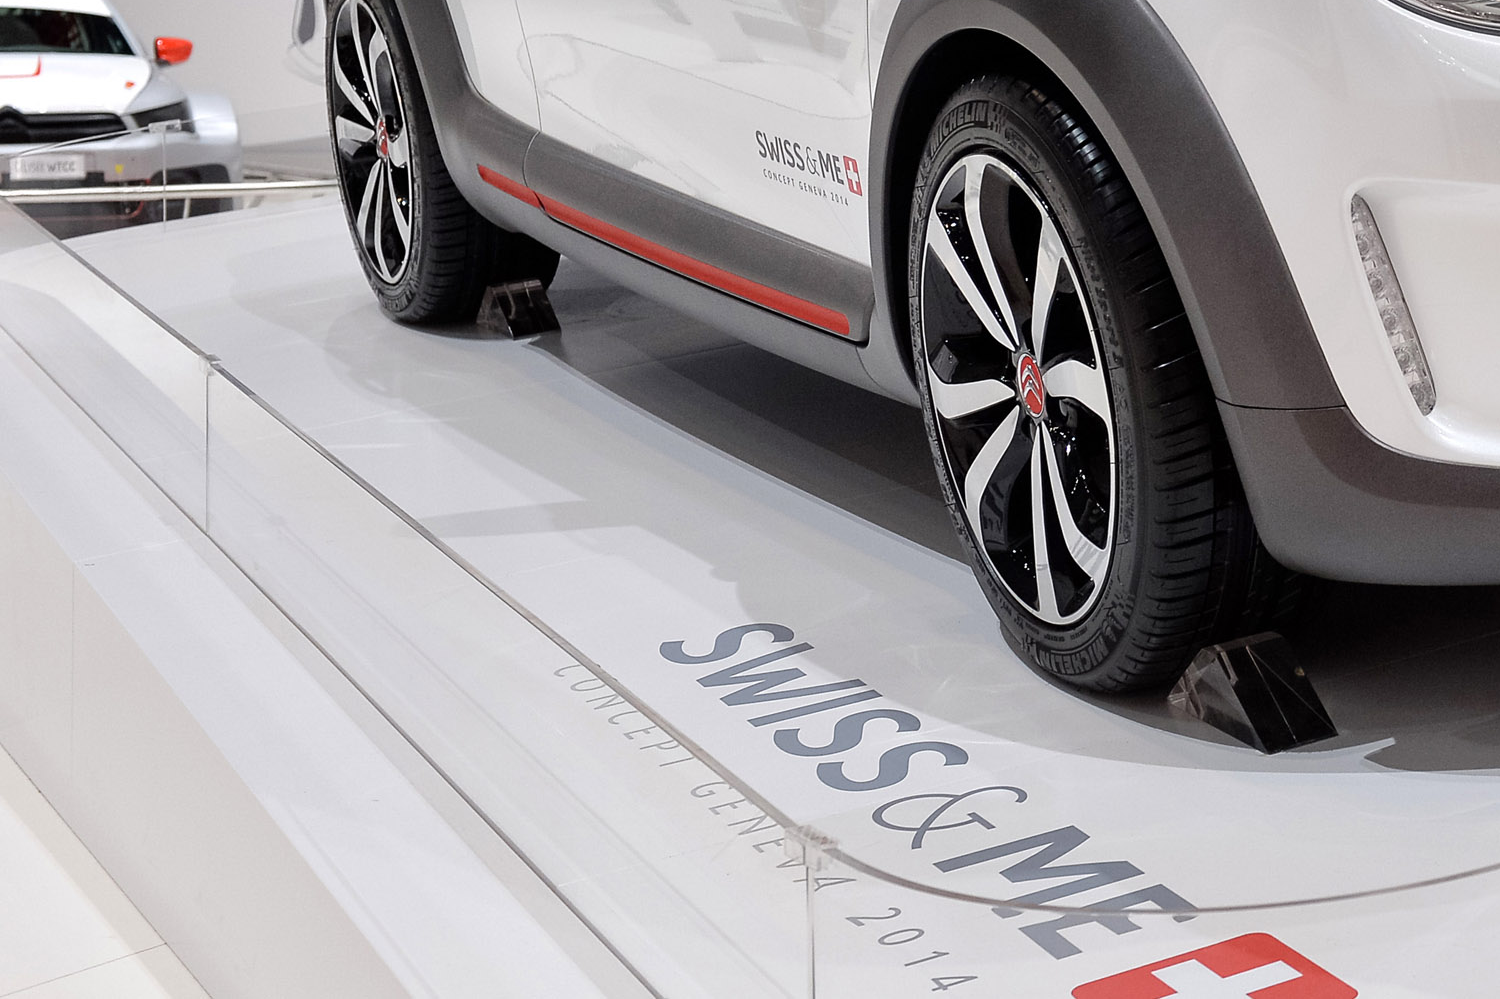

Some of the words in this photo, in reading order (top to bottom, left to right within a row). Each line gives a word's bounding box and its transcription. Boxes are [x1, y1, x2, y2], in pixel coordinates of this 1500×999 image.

[763, 168, 795, 187] CONCEPT
[799, 181, 828, 198] GENEVA
[831, 192, 849, 206] 2014
[659, 622, 969, 793] SWISS
[933, 824, 1199, 960] ME
[845, 906, 978, 993] 2014
